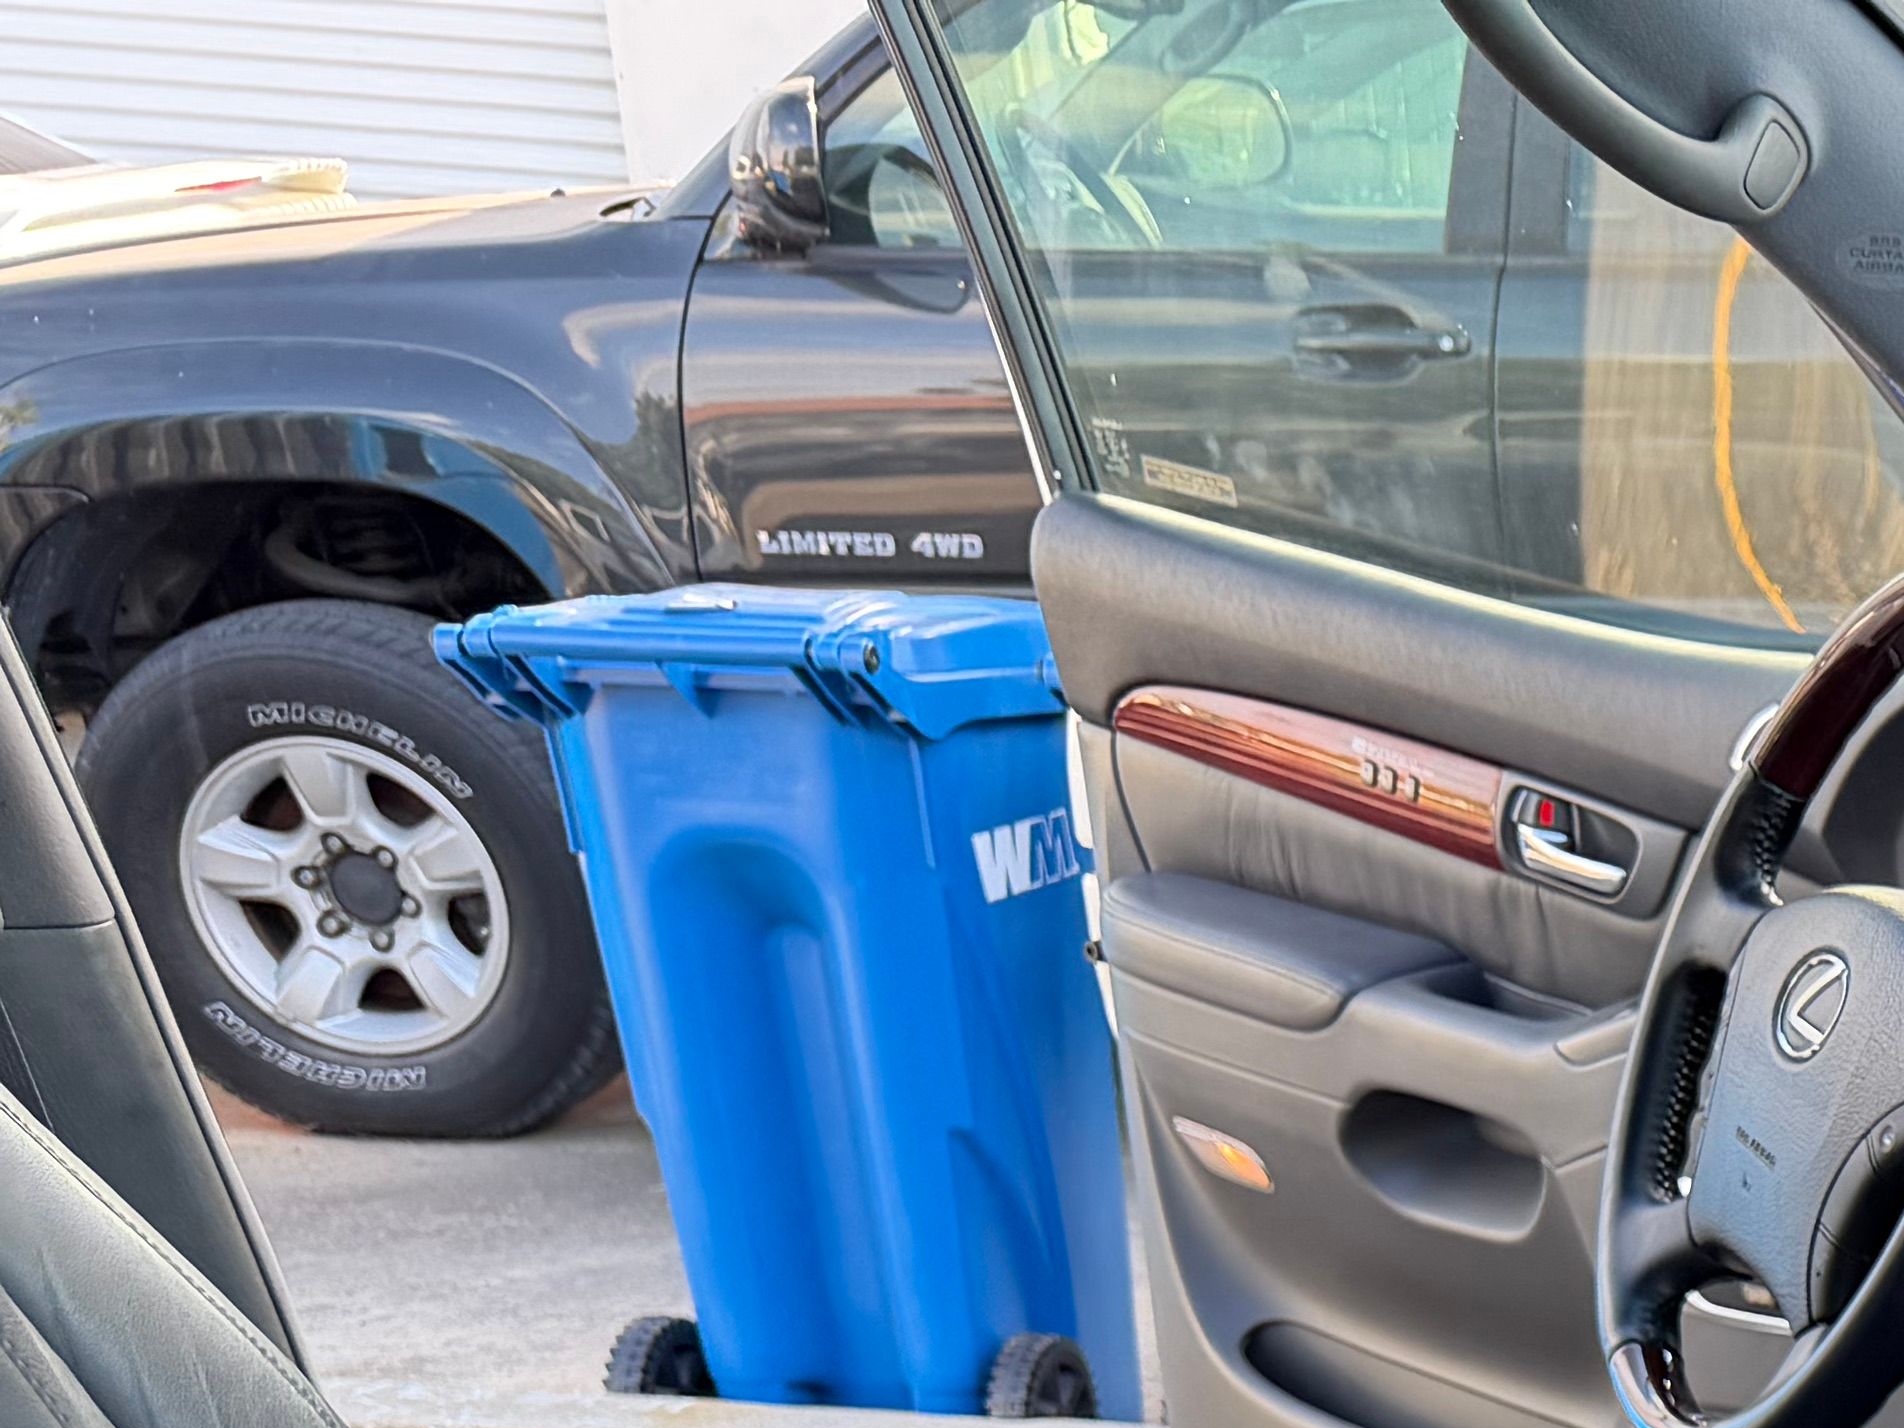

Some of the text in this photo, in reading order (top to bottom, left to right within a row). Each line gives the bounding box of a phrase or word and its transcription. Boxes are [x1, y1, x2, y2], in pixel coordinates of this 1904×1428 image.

[756, 529, 984, 558] LIMITED 4WD
[247, 701, 474, 799] MICHELIN
[970, 806, 1080, 904] WM
[203, 1000, 427, 1091] MICHELIN
